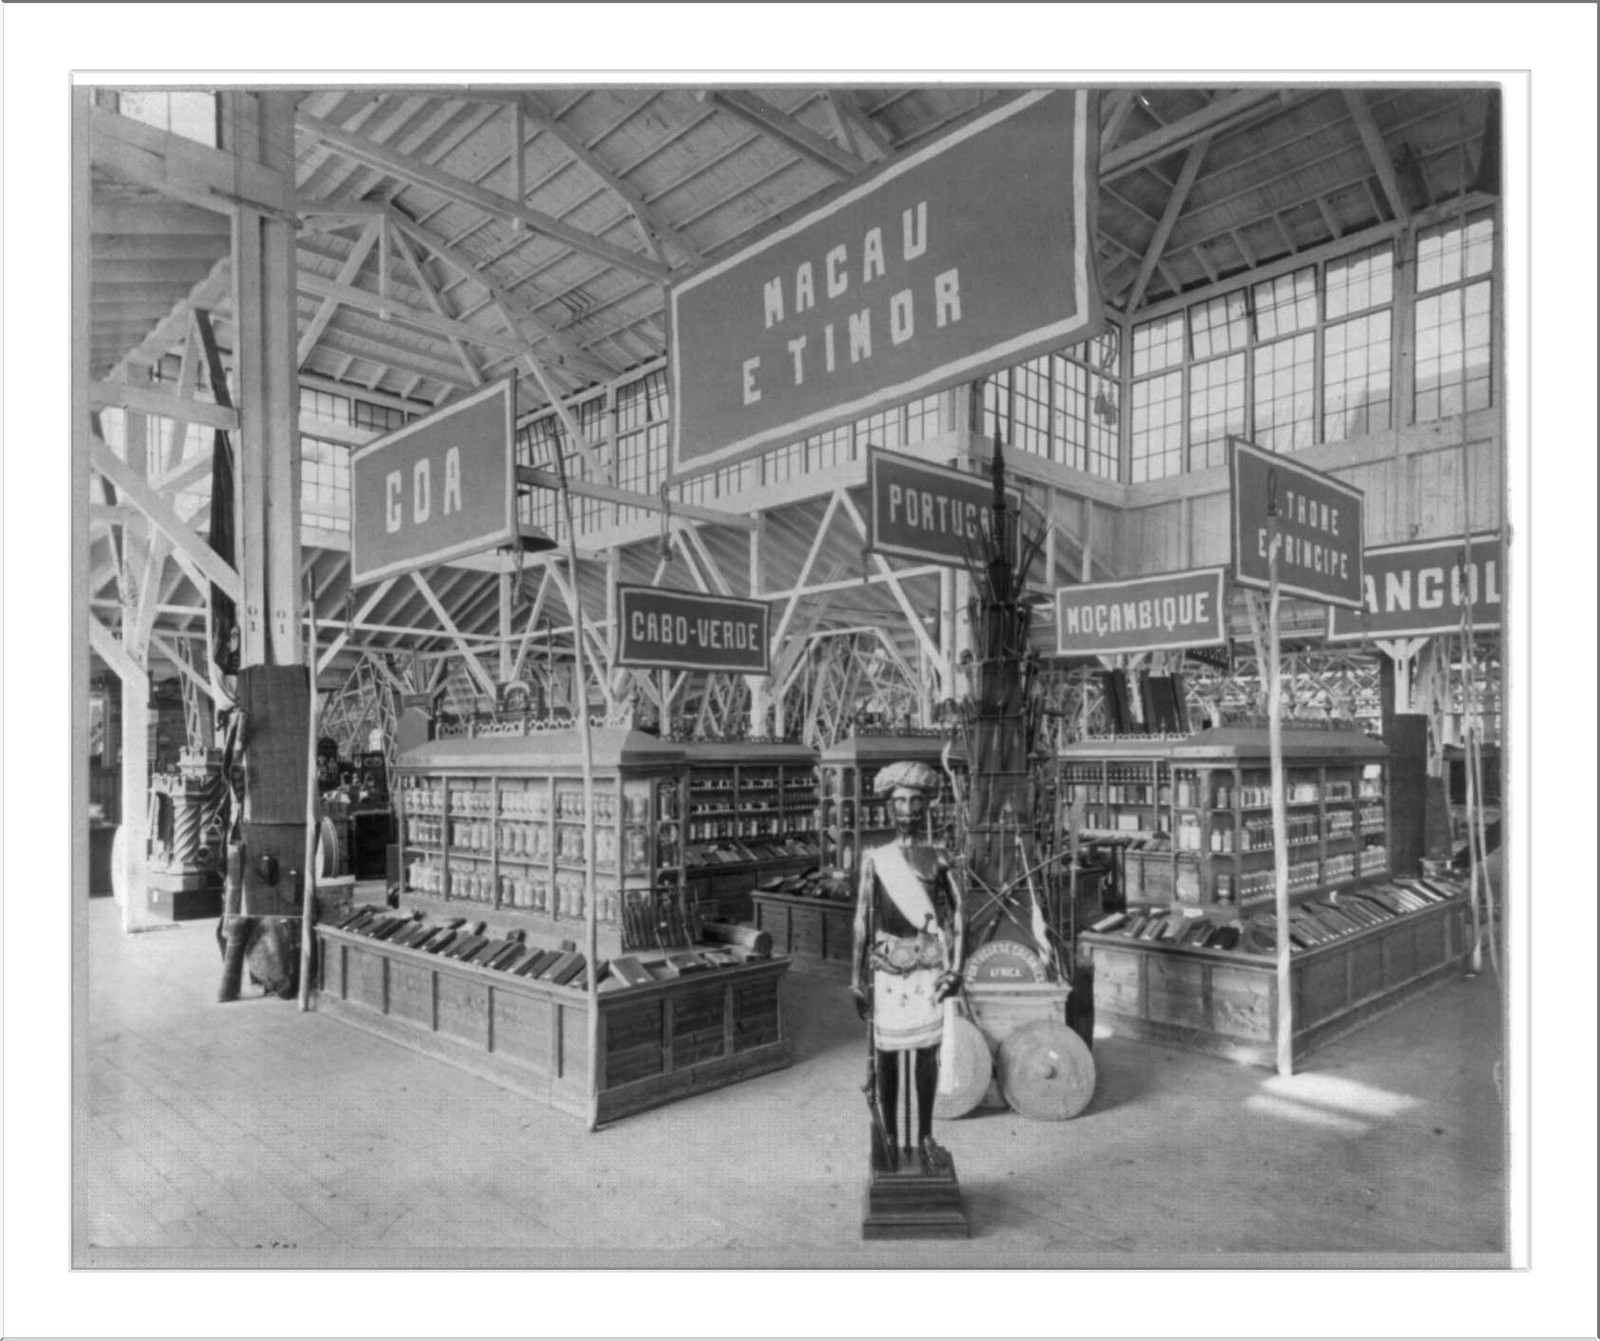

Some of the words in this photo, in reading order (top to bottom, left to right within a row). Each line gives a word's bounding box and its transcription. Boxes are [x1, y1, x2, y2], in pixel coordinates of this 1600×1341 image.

[763, 201, 927, 329] MACAU
[742, 356, 762, 405] E
[788, 267, 961, 385] TIMOR
[386, 446, 461, 534] GOA
[889, 484, 996, 545] PORTUGA
[1258, 528, 1267, 558] E
[631, 610, 759, 651] CABO-VERDE
[1067, 592, 1209, 637] MOÇAMBIQUE
